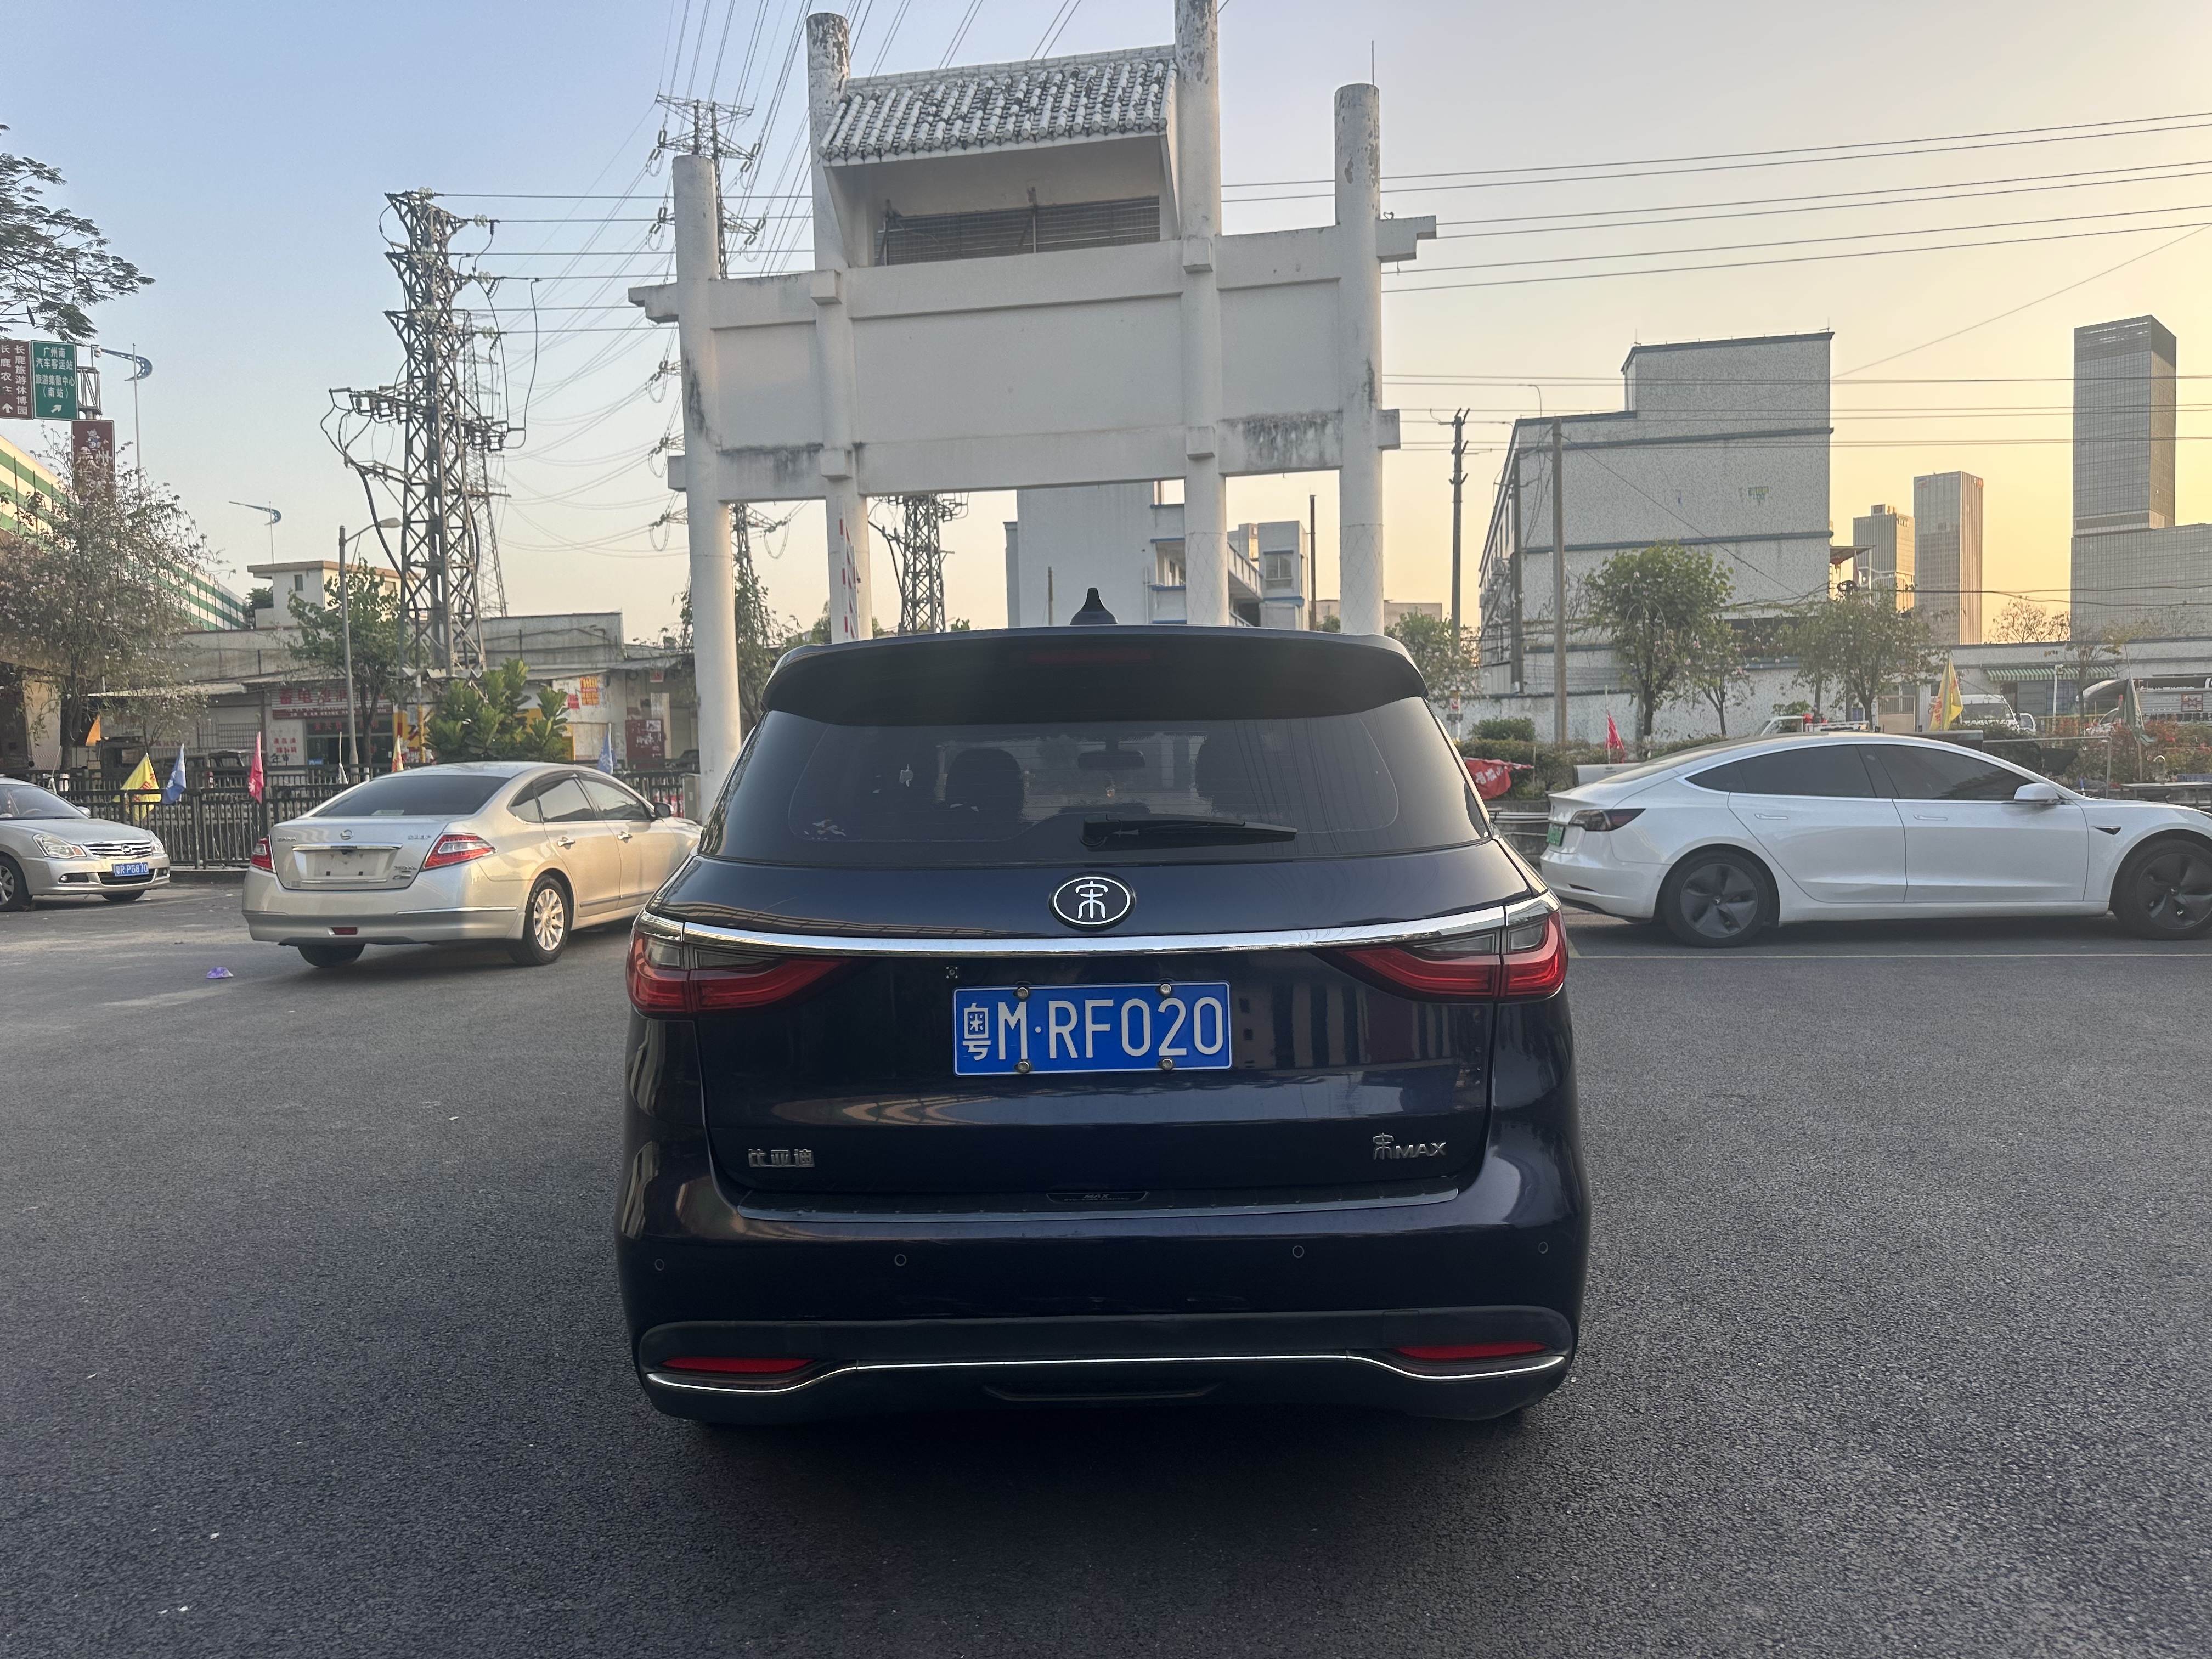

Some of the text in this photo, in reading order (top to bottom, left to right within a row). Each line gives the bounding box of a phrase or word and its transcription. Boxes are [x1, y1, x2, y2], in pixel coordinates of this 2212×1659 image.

[43, 346, 65, 358] 广州南
[36, 358, 73, 370] 汽车客运站
[14, 345, 27, 415] 长鹿旅游休博园
[35, 374, 75, 387] 旅游集散中心
[1075, 880, 1109, 919] 宋
[962, 997, 1224, 1060] 粤M·RF020
[748, 1148, 815, 1168] 比亚迪
